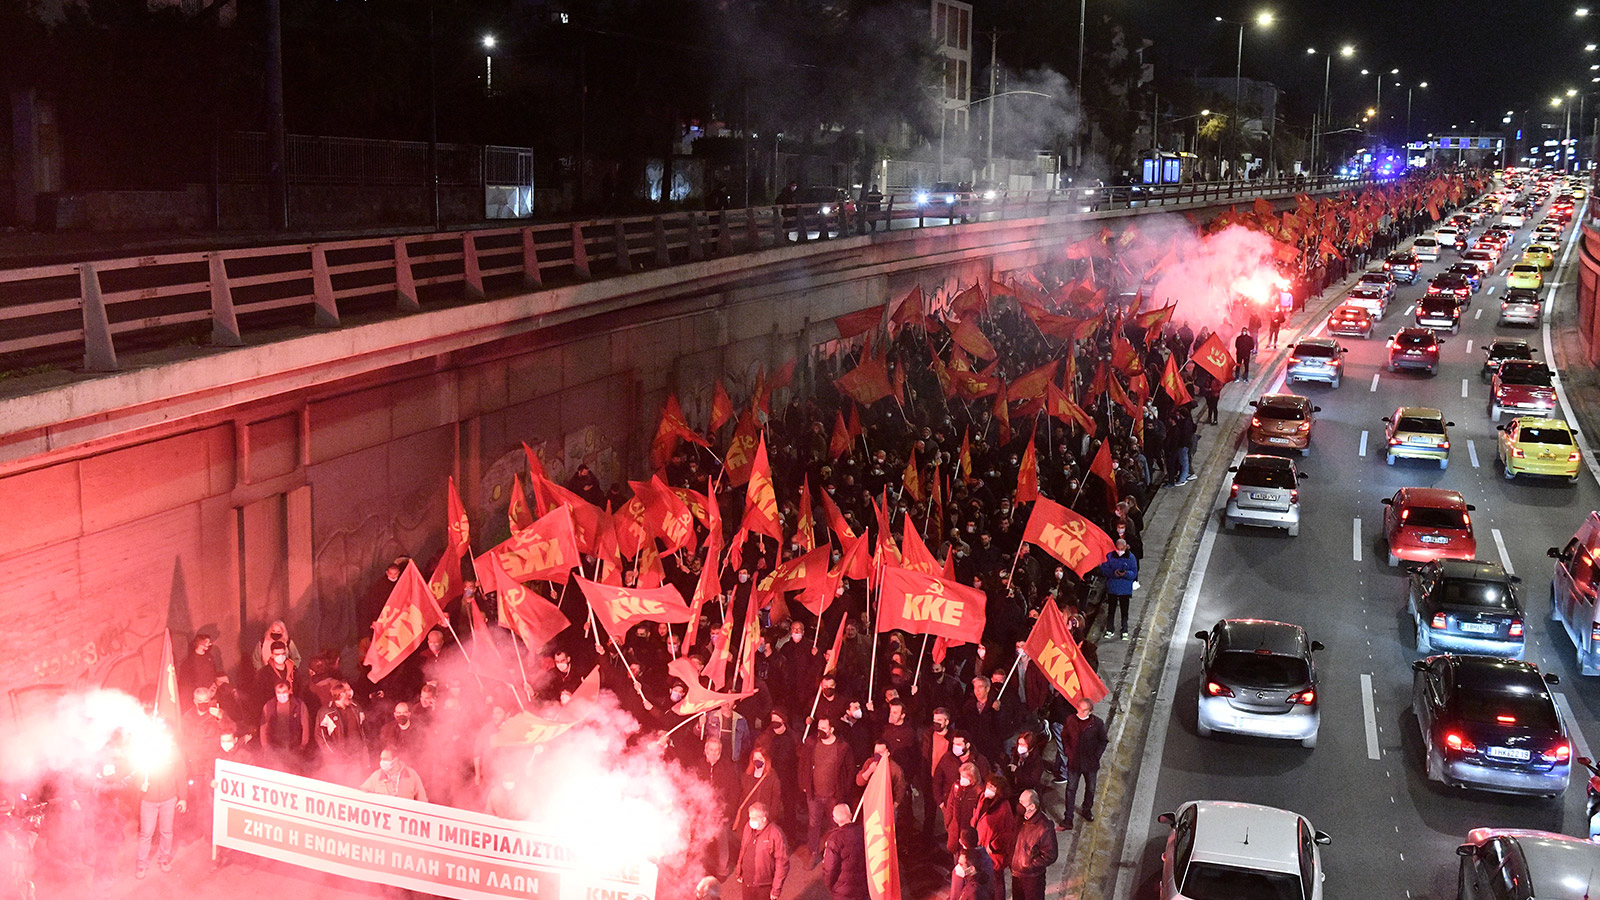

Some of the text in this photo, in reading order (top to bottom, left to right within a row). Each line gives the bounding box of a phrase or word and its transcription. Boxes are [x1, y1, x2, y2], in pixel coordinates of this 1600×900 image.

[902, 593, 964, 626] ΚΚΕ
[1037, 639, 1081, 699] ΚΚΕ
[221, 777, 245, 799] ΟΧΙ
[252, 784, 299, 811] ΣΤΟΥΣ
[305, 796, 391, 831] ΠΟΛΕΜΟΥΣ
[398, 815, 431, 839] ΤΩΝ
[244, 819, 539, 894] ΖΗΤΩ Η ΕΝΩΜΕΝΗ ΠΑΛΗ ΤΩΝ ΛΑΩΝ
